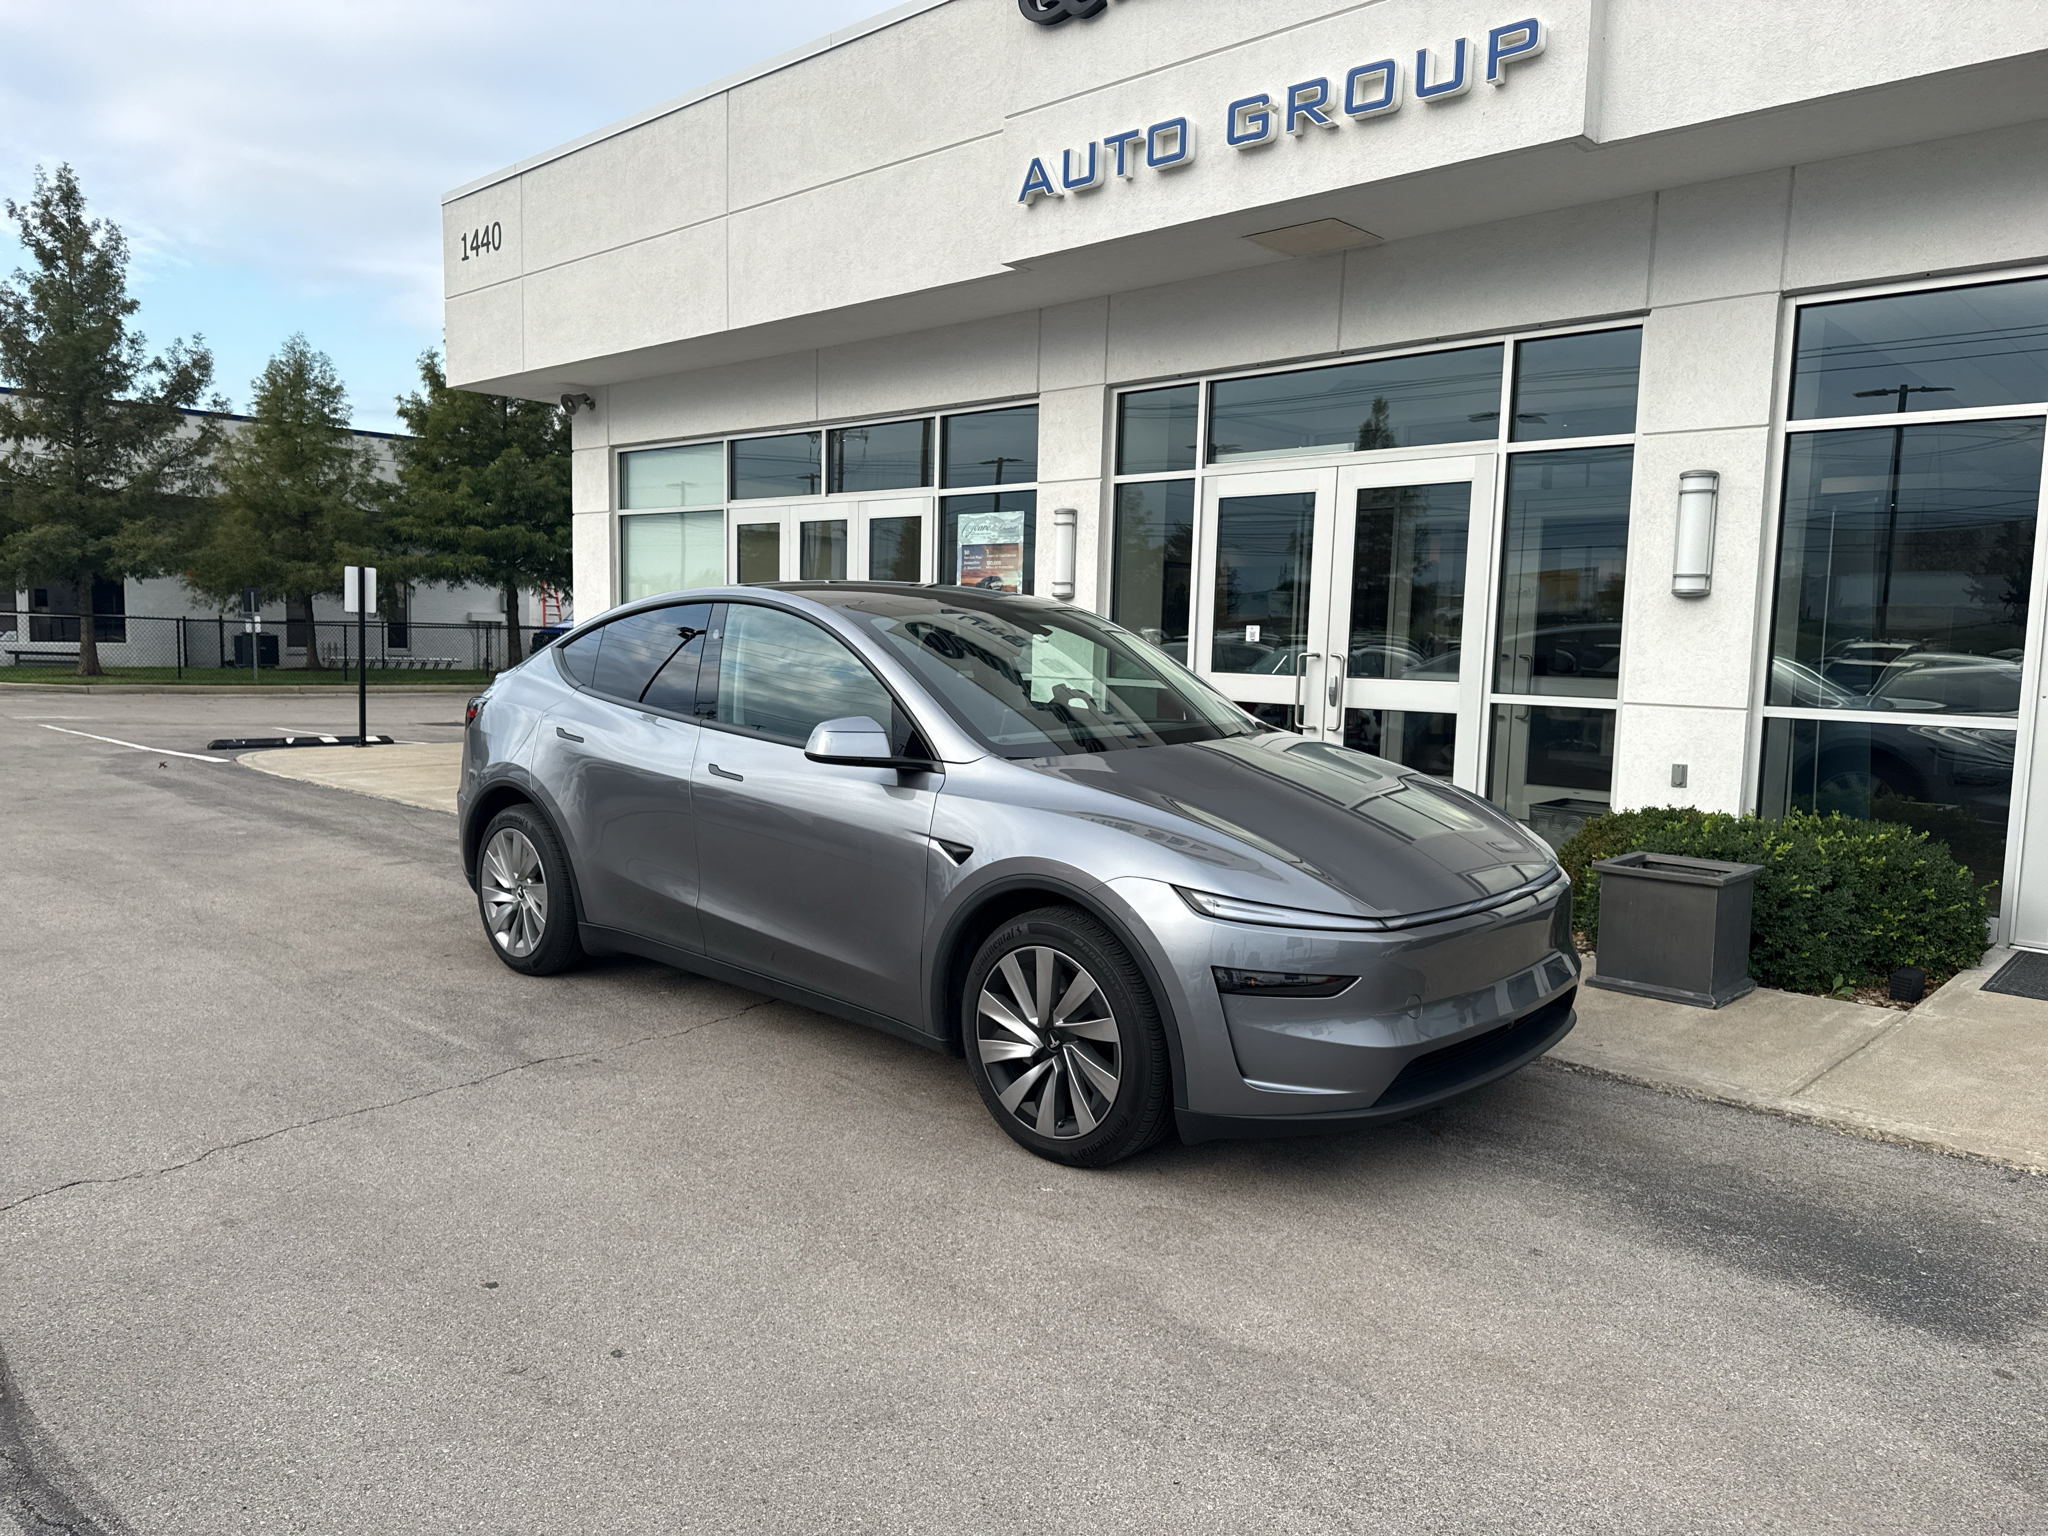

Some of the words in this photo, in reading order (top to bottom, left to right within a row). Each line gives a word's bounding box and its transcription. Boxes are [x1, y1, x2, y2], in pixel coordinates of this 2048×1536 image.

[1018, 116, 1195, 205] AUTO
[1227, 17, 1546, 150] GROUP
[461, 221, 502, 262] 1440
[974, 928, 1015, 976] Continental
[1078, 1114, 1128, 1160] Continental
